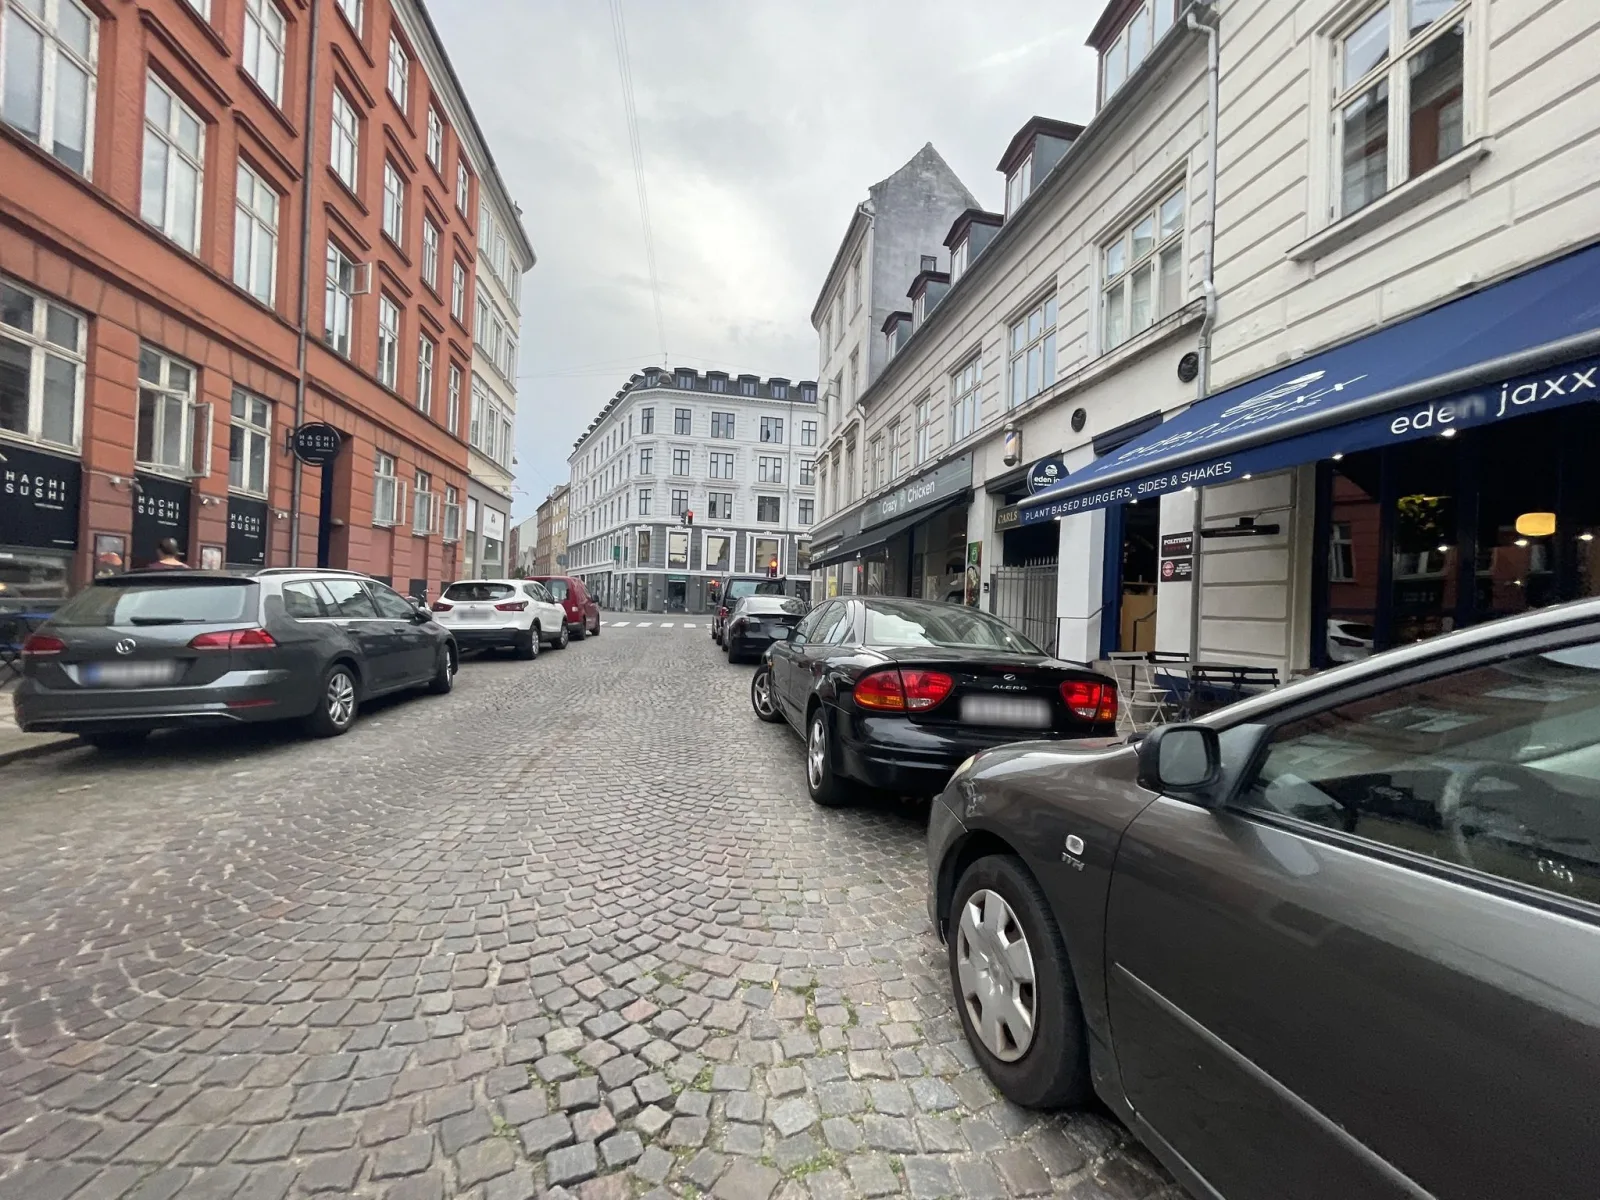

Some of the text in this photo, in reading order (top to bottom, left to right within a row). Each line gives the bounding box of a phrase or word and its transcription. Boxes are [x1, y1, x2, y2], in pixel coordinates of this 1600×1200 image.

[1496, 367, 1598, 417] jaxx
[299, 440, 334, 448] SUSHI
[5, 471, 65, 491] HACHI
[1033, 476, 1052, 484] eden
[5, 483, 65, 502] SUSHI
[882, 481, 935, 514] Crazy Chicken
[1025, 461, 1232, 520] PLANT BASED BURGERS, SIDES & SHAKES
[138, 495, 179, 510] HACHI
[138, 505, 179, 519] SUSHI
[230, 513, 260, 525] HACHI
[997, 510, 1018, 524] CARLS
[230, 521, 260, 533] SUSHI
